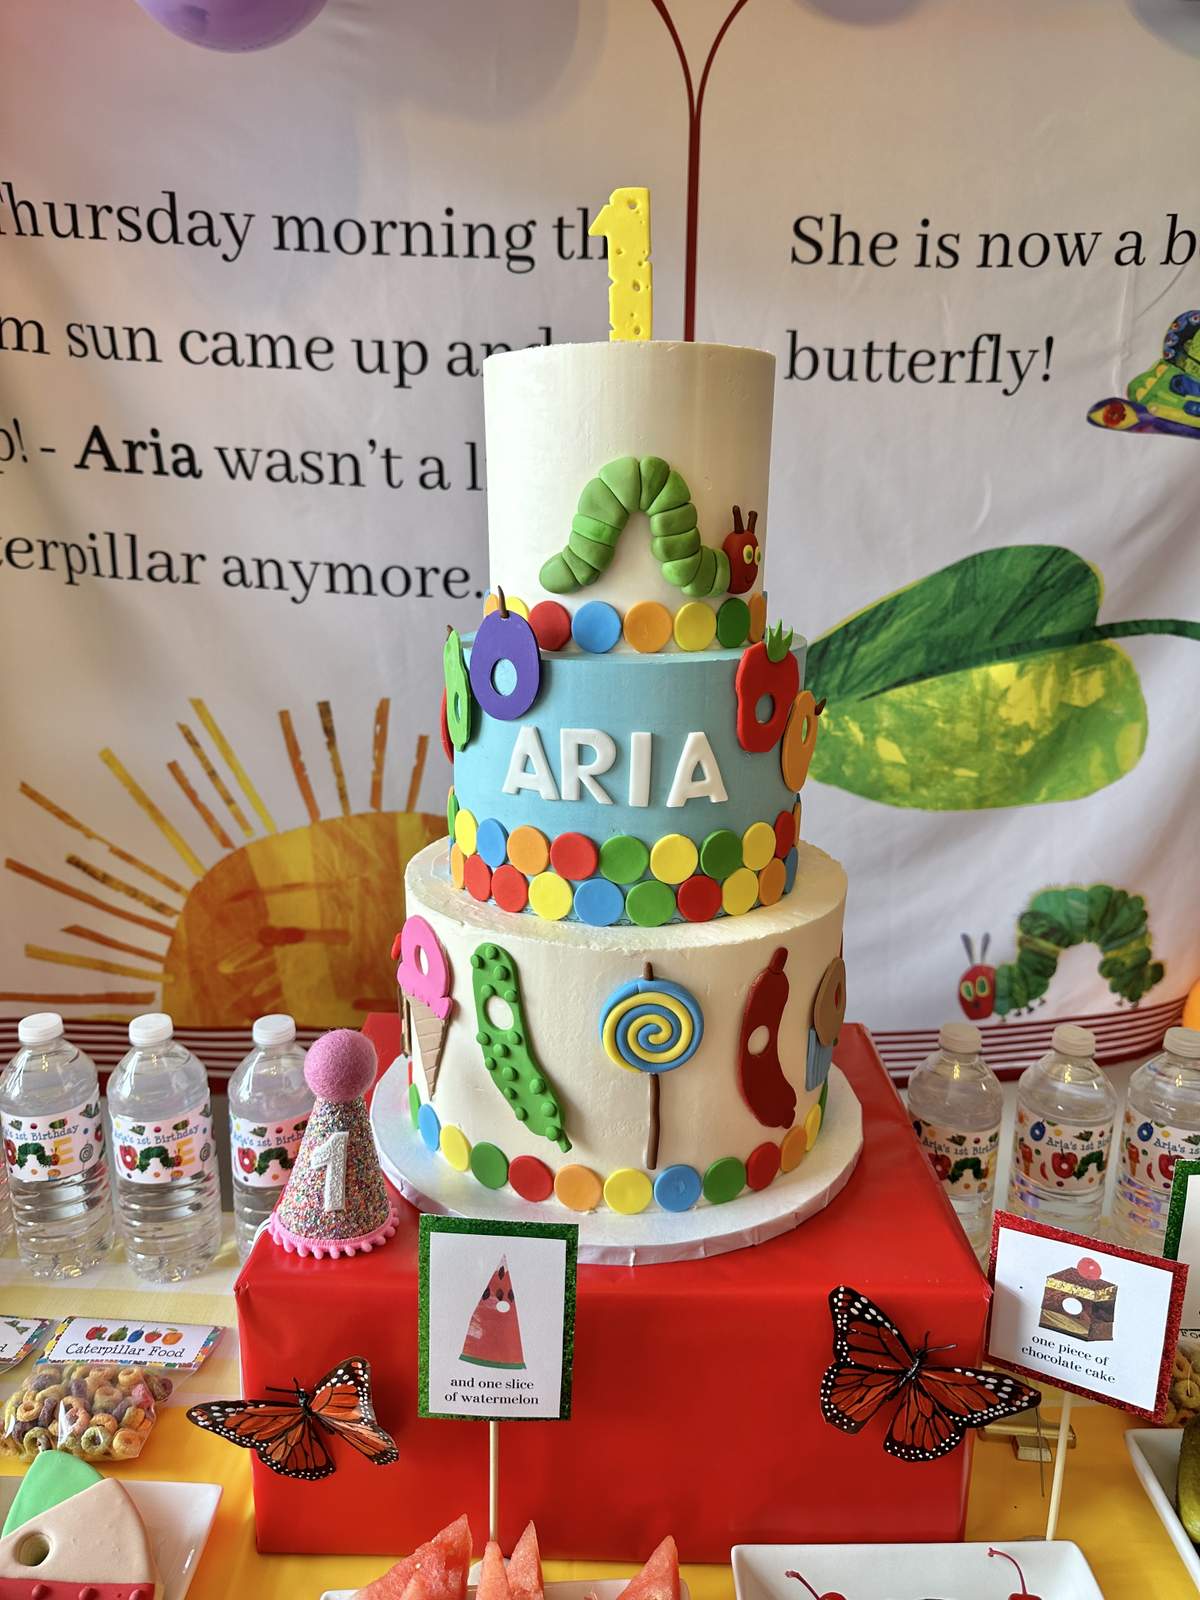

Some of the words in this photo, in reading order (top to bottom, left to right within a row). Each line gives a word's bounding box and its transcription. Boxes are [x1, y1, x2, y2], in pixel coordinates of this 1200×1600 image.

[0, 181, 255, 262] hursday
[272, 207, 537, 274] morning
[790, 213, 899, 267] She
[914, 218, 961, 269] is
[976, 229, 1103, 268] now
[1114, 230, 1146, 267] a
[65, 322, 164, 364] sun
[179, 326, 336, 373] came
[351, 336, 429, 389] up
[783, 330, 1055, 397] butterfly!
[74, 424, 204, 480] Aria
[418, 456, 452, 491] a
[0, 532, 206, 587] erpillar
[222, 552, 485, 605] anymore.
[502, 725, 729, 808] ARIA
[31, 1124, 79, 1141] Birthday
[154, 1124, 200, 1146] Birthday
[310, 1131, 351, 1213] 1
[65, 1343, 146, 1357] Caterpillar
[147, 1346, 186, 1358] Food
[1022, 1346, 1082, 1372] chocolate
[1086, 1365, 1116, 1383] cake
[1032, 1336, 1055, 1349] one
[1058, 1343, 1092, 1360] piece
[1095, 1355, 1110, 1367] of
[444, 1391, 458, 1402] of
[462, 1393, 539, 1405] watermelon
[451, 1377, 475, 1388] and
[478, 1379, 503, 1389] one
[505, 1378, 534, 1389] slice
